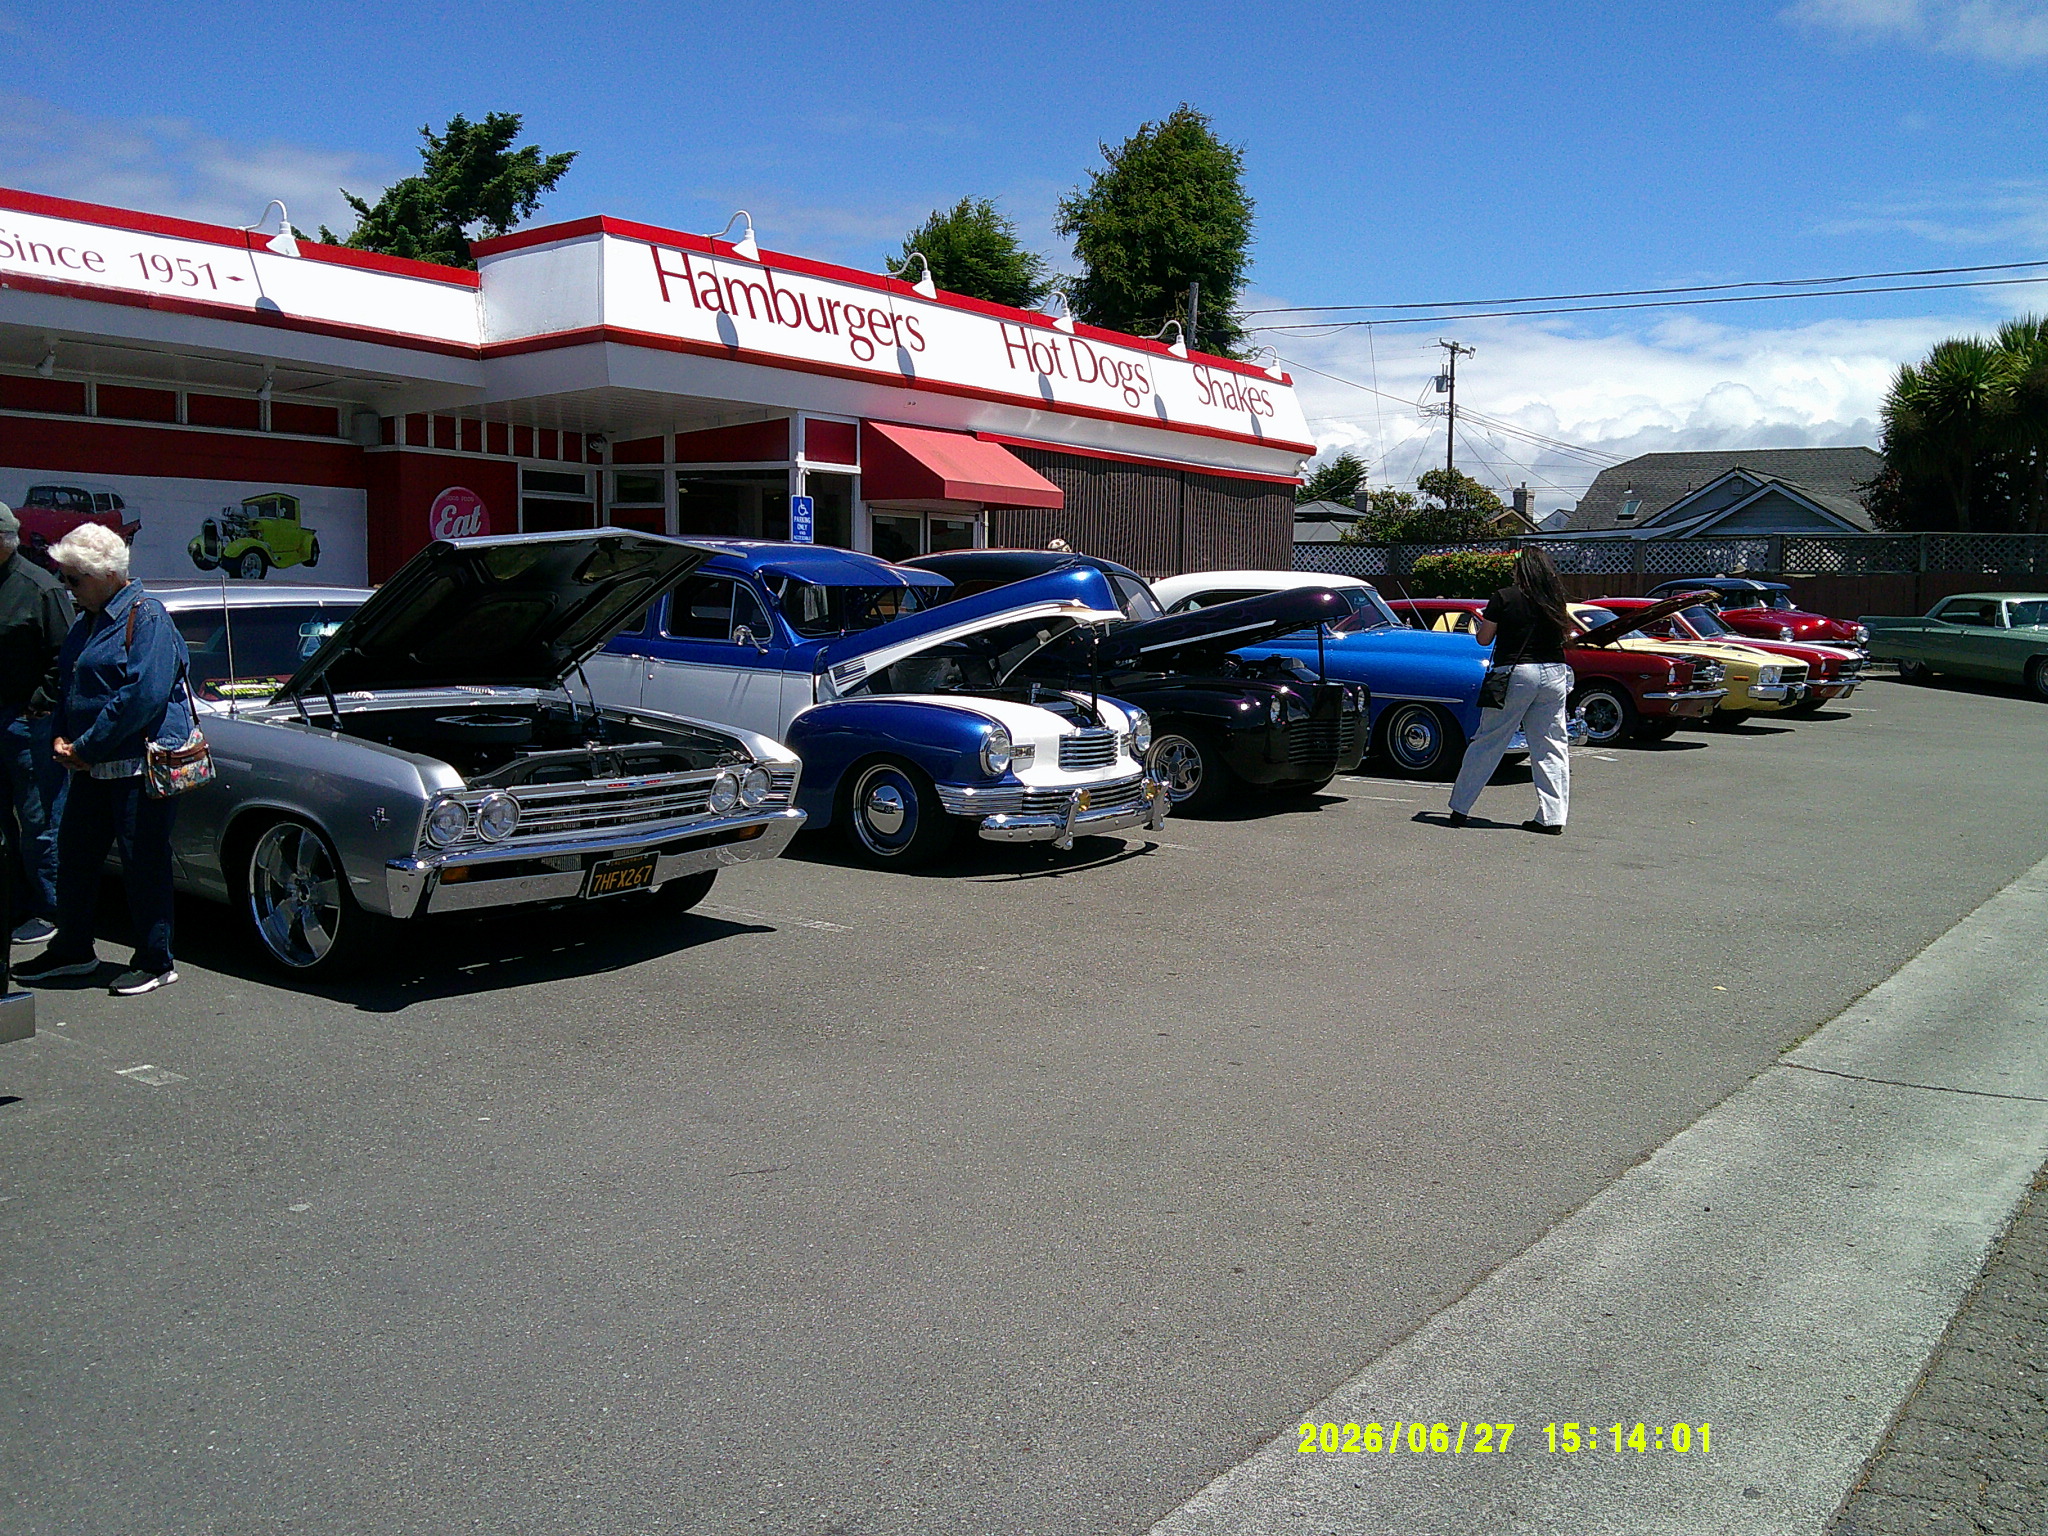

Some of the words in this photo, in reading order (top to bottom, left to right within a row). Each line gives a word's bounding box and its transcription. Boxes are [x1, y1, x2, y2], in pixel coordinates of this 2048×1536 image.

[0, 228, 106, 273] Since
[650, 245, 926, 362] Hamburgers
[1000, 322, 1068, 379] Hot
[1068, 337, 1150, 408] Dogs
[1192, 363, 1275, 418] Shakes
[435, 504, 482, 540] Eat
[593, 864, 653, 892] 7HFX267
